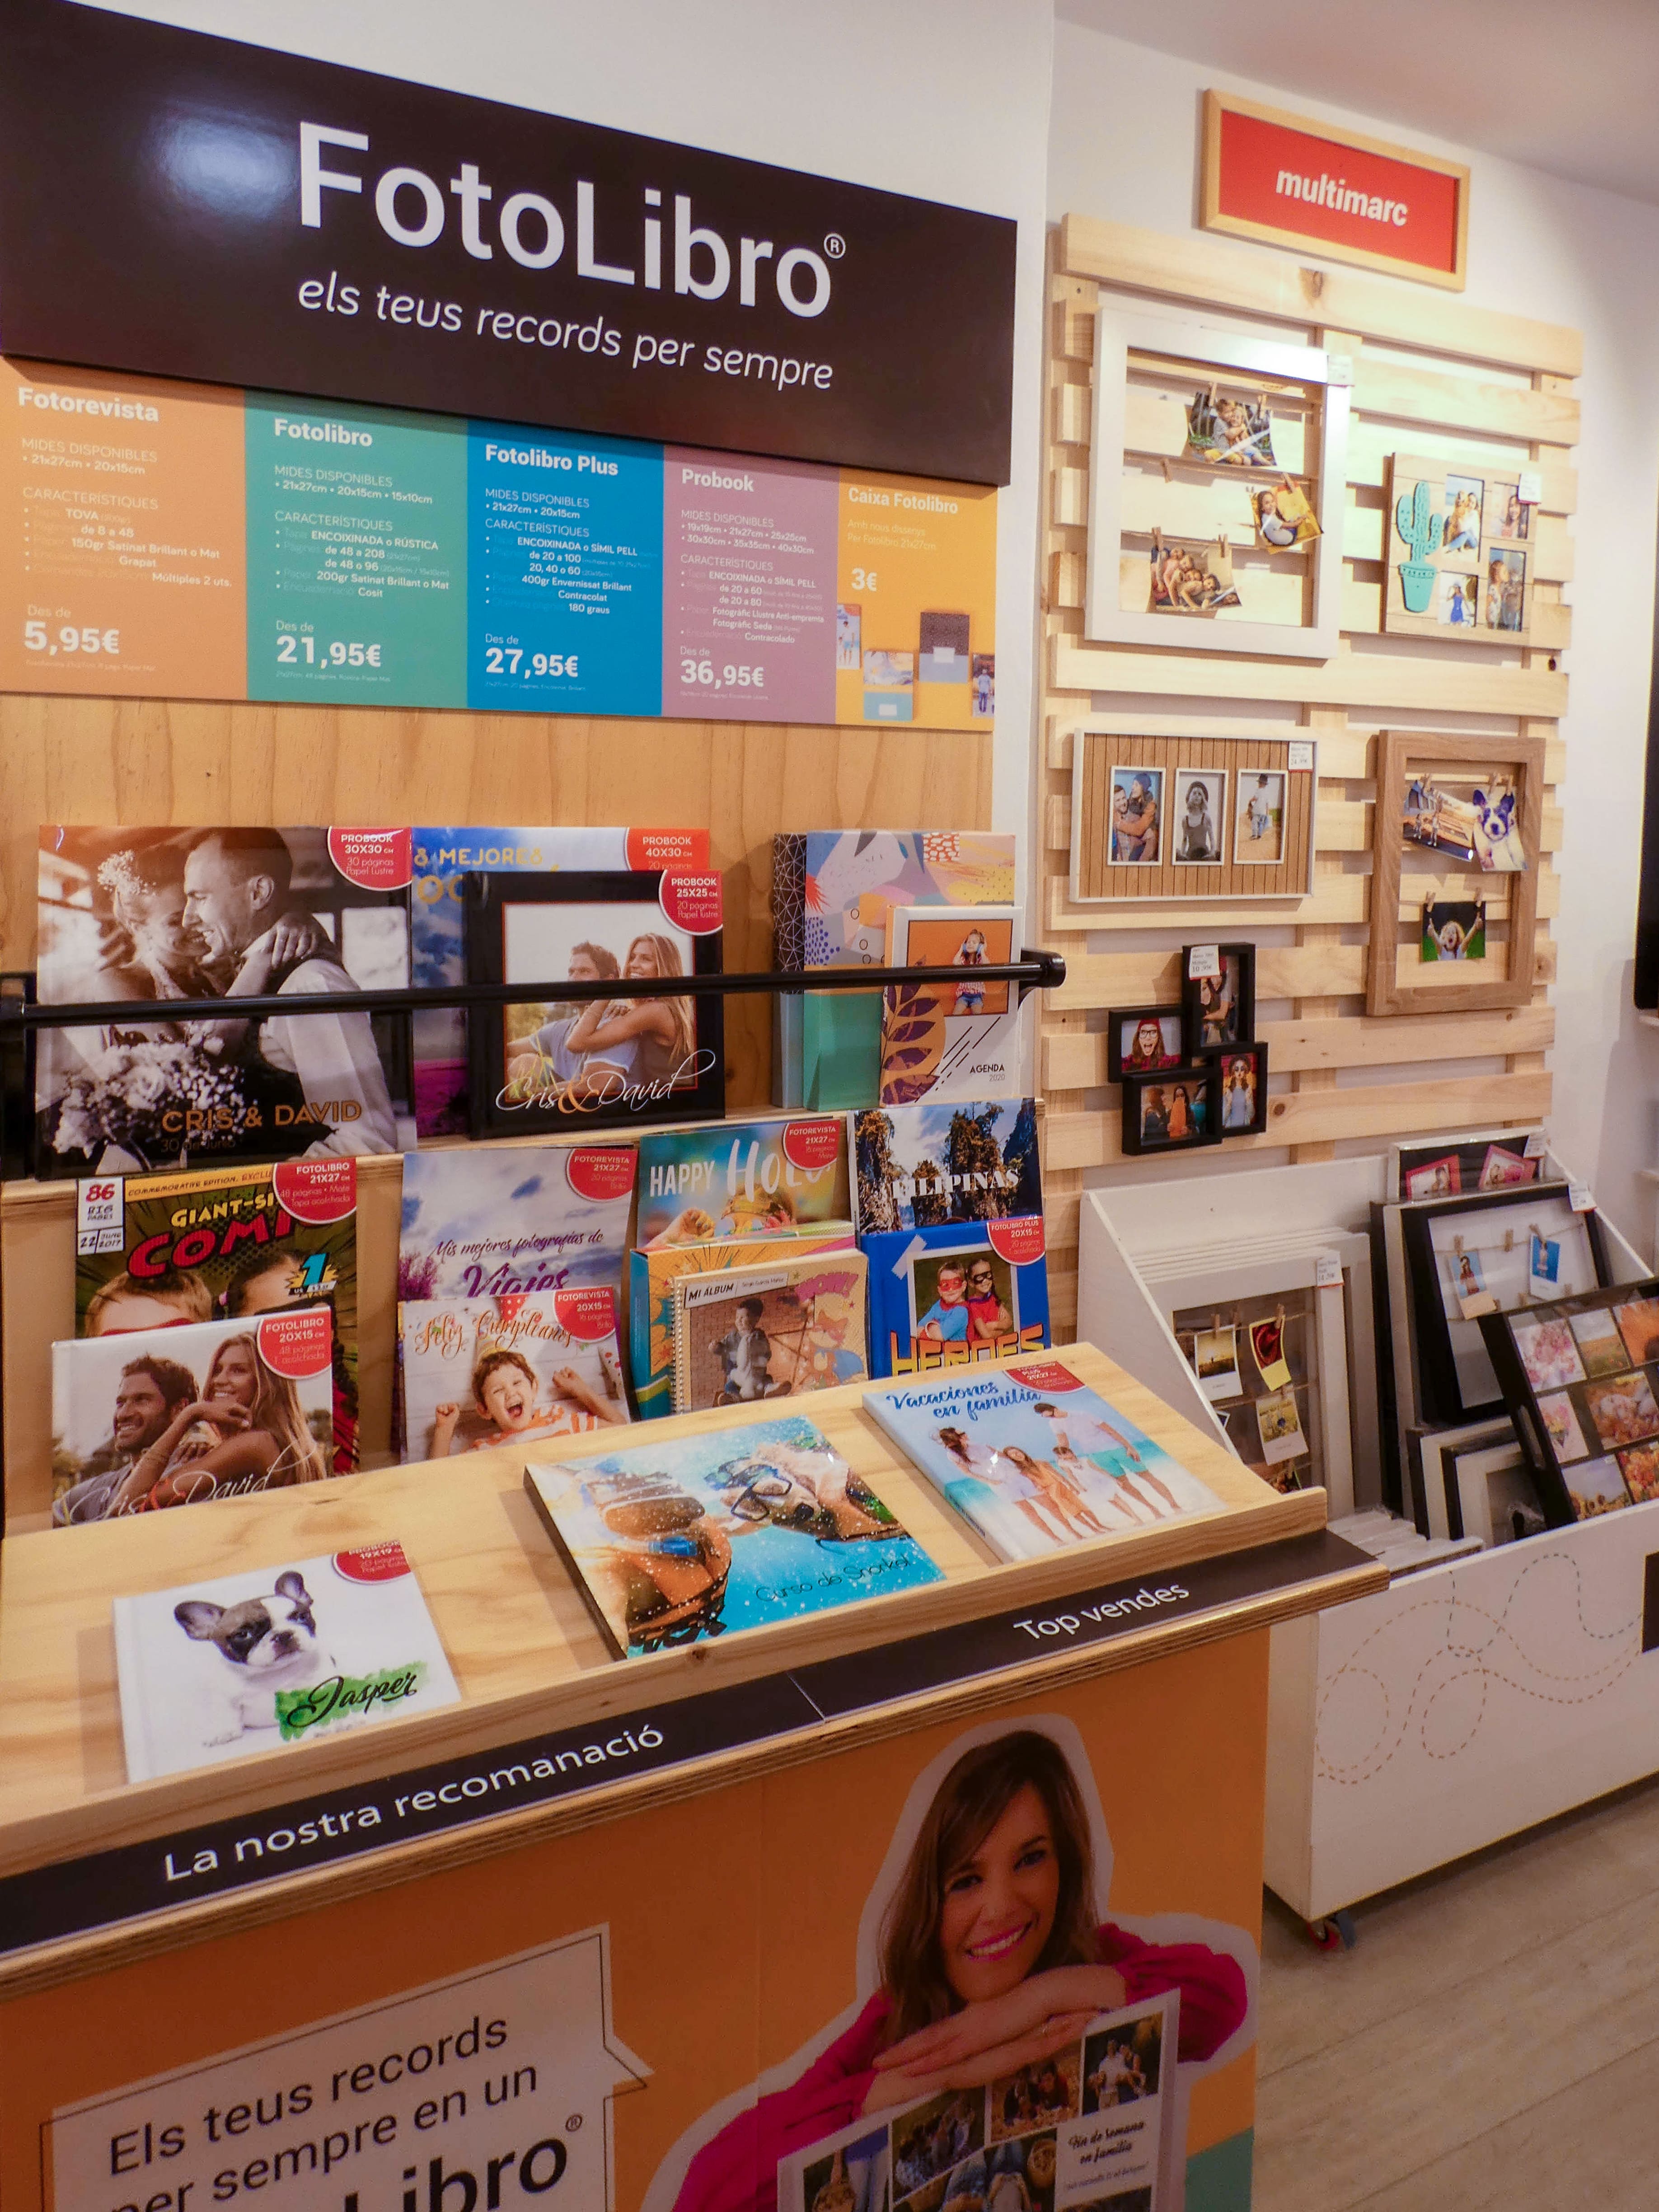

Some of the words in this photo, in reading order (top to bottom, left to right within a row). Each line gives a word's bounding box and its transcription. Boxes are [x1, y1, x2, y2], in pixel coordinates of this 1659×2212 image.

[1275, 169, 1408, 226] multimarc
[298, 271, 361, 316] els
[376, 285, 463, 332] teus
[476, 306, 622, 357] records
[633, 332, 695, 369] per
[703, 344, 833, 391] sempre
[18, 387, 159, 422] Fotorevista
[274, 418, 373, 446] Fotolibro
[22, 438, 65, 453] MIDES
[70, 442, 158, 463] DISPONIBLES
[32, 454, 82, 469] 21x27cm
[94, 460, 145, 475] 20x15cm
[486, 444, 572, 470] Fotolibro
[577, 455, 619, 476] Plus
[275, 464, 312, 479] MIDES
[316, 469, 393, 488] DISPONIBLES
[681, 469, 755, 492] Probook
[283, 480, 327, 493] 21x27cm
[337, 486, 382, 499] 20x15cm
[392, 492, 432, 504] 15x10cm
[485, 488, 519, 501] MIDES
[522, 492, 590, 508] DISPONIBLES
[848, 487, 890, 506] Caixa
[894, 492, 958, 514] Fotolibro
[66, 507, 98, 520] TOVA
[492, 501, 531, 515] 21x27cm
[540, 506, 580, 519] 20x15cm
[681, 510, 711, 520] MIDES
[714, 512, 774, 528] DISPONIBLES
[119, 527, 135, 538] 48
[311, 530, 384, 546] ENCOIXINADA
[729, 527, 763, 538] 21x27cm
[108, 540, 146, 553] Satinat
[149, 544, 187, 556] Brillant
[200, 548, 220, 559] Mat
[340, 546, 353, 556] 48
[365, 548, 384, 559] 208
[517, 536, 581, 551] ENCOIXINADA
[617, 545, 637, 556] PELL
[778, 543, 815, 555] 40x30cm
[119, 555, 156, 568] Grapat
[340, 560, 353, 570] 48
[542, 552, 555, 561] 20
[565, 553, 581, 563] 100
[546, 564, 558, 573] 40
[568, 566, 581, 576] 60
[317, 570, 347, 584] 200gr
[351, 573, 384, 585] Satinat
[387, 576, 421, 588] Brillant
[432, 580, 449, 590] Mat
[522, 575, 550, 587] 400gr
[552, 577, 600, 590] Envernissat
[603, 581, 632, 592] Brillant
[709, 572, 766, 584] ENCOIXINADA
[797, 578, 816, 588] PELL
[851, 567, 877, 592] 3€
[358, 587, 383, 597] Cosit
[558, 590, 607, 602] Contracolat
[28, 604, 52, 618] Des
[55, 605, 71, 618] de
[569, 603, 585, 613] 180
[587, 606, 610, 615] graus
[276, 619, 296, 632] Des
[300, 622, 314, 633] de
[753, 621, 773, 631] Seda
[23, 620, 119, 656] 5,95€
[485, 633, 503, 644] Des
[506, 634, 519, 645] de
[276, 635, 382, 670] 21,95€
[680, 646, 695, 656] Des
[698, 647, 710, 656] de
[485, 647, 579, 680] 27,95€
[680, 659, 764, 689] 36,95€
[341, 834, 393, 843] PROBOOK
[642, 836, 691, 845] PROBOOK
[345, 844, 382, 853] 30X30
[646, 848, 681, 857] 40X30
[676, 889, 707, 897] 25X25
[970, 1064, 1004, 1074] AGENDA
[989, 1073, 1005, 1082] 2020
[587, 1049, 716, 1111] David
[162, 1108, 235, 1133] CRIS
[244, 1106, 262, 1128] &
[275, 1099, 361, 1126] DAVID
[789, 1126, 836, 1135] FOTOREVISTA
[806, 1136, 828, 1144] 21X27
[574, 1155, 629, 1164] FOTOREVISTA
[296, 1162, 350, 1175] FOTOLIBRO
[310, 1173, 340, 1184] 21X27
[650, 1160, 715, 1197] HAPPY
[86, 1184, 115, 1202] 86
[171, 1192, 274, 1228] GIANT-SI
[992, 1222, 1023, 1231] FOTOLIBRO
[1011, 1228, 1032, 1238] 20X15
[128, 1210, 292, 1278] COMI
[430, 1239, 456, 1263] Mis
[461, 1237, 511, 1261] mejores
[588, 1229, 604, 1243] de
[302, 1253, 330, 1287] 1
[558, 1291, 610, 1302] FOTOREVISTA
[689, 1291, 702, 1301] MI
[576, 1301, 602, 1312] 20X15
[266, 1318, 324, 1333] FOTOLIBRO
[279, 1330, 313, 1343] 20X15
[890, 1324, 1045, 1376] HEROES
[886, 1382, 998, 1411] Vacaciones
[933, 1406, 961, 1418] en
[966, 1388, 1041, 1422] familia
[349, 1540, 399, 1555] PROBOOK
[755, 1582, 813, 1603] Curso
[818, 1572, 842, 1589] de
[1013, 1614, 1081, 1640] Top
[1080, 1583, 1190, 1622] vendes
[287, 1672, 417, 1728] Jasper
[164, 1847, 220, 1881] La
[234, 1803, 382, 1863] nostra
[394, 1723, 665, 1818] recomanació
[110, 2122, 186, 2177] Els
[204, 2080, 313, 2142] teus
[331, 2014, 509, 2101] records
[213, 2113, 398, 2201] sempre
[414, 2087, 467, 2132] en
[484, 2063, 539, 2106] un
